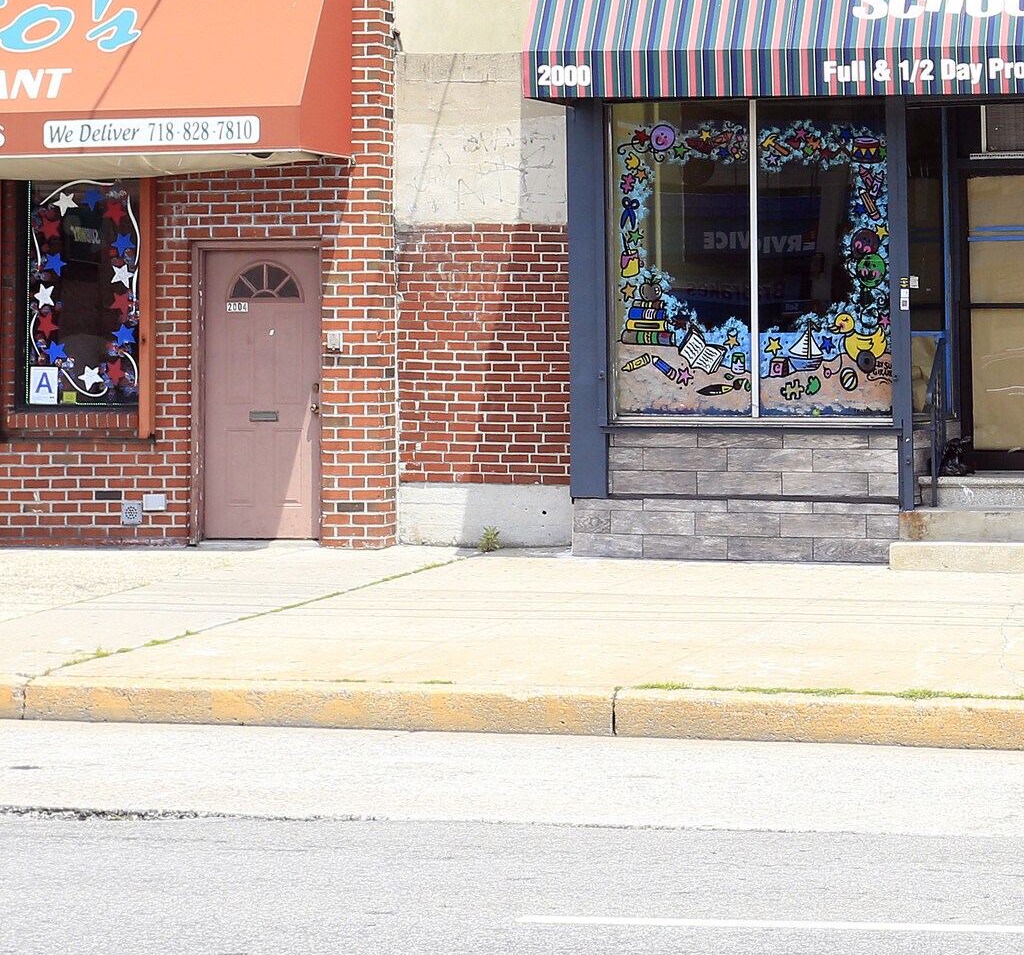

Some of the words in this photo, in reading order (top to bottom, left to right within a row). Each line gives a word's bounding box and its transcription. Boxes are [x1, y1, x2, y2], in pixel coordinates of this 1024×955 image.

[537, 64, 592, 87] 2000
[823, 60, 866, 84] Full
[873, 61, 892, 82] &
[899, 59, 935, 82] 1/2
[940, 58, 982, 84] Day
[49, 125, 73, 144] We
[79, 123, 140, 142] Deliver
[148, 119, 253, 142] 718-828-7810
[227, 302, 248, 312] 2004
[35, 371, 53, 394] A
